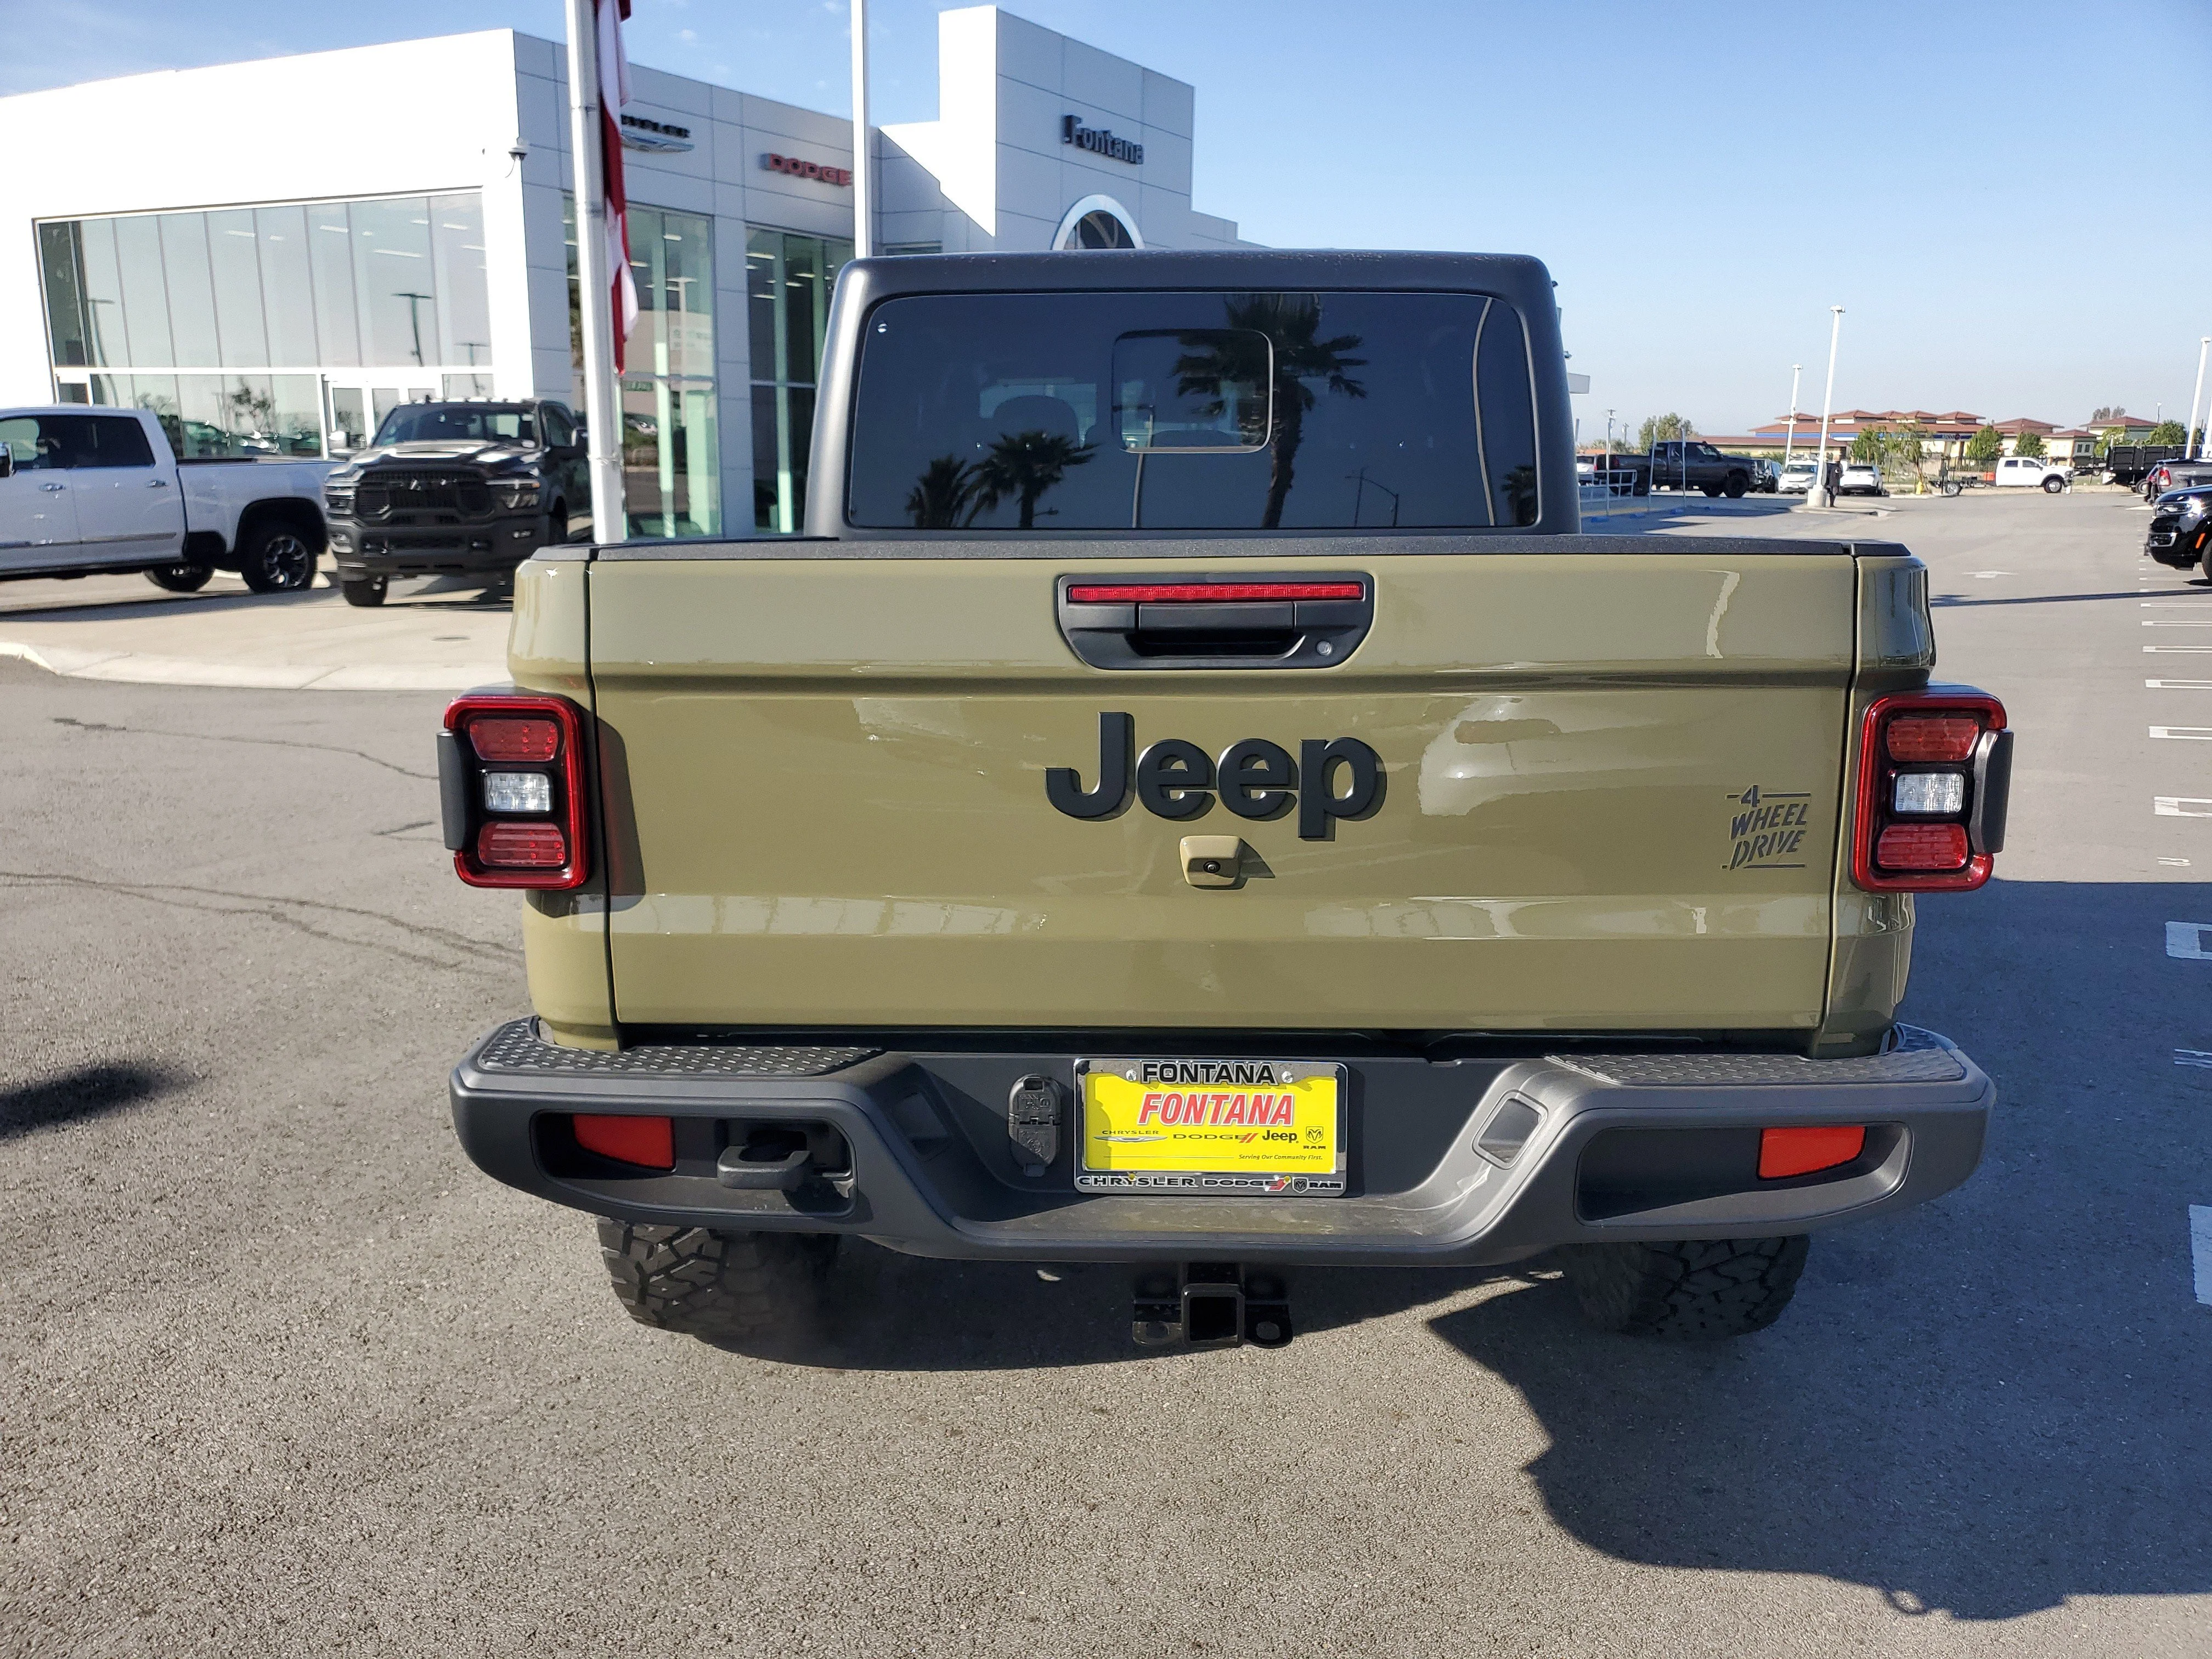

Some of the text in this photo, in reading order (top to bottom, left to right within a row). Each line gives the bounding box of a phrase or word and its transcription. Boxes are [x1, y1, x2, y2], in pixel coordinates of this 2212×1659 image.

[767, 153, 853, 187] DODGE
[1045, 712, 1381, 839] Jeep
[1739, 784, 1760, 808] 4
[1729, 803, 1809, 840] WHEEL
[1729, 830, 1808, 871] DRIVE
[1141, 1062, 1279, 1086] FONTANA
[1137, 1092, 1294, 1126] FONTANA
[1262, 1130, 1298, 1143] Jeep
[1076, 1175, 1344, 1190] CHRYSLER DODGE RAM
